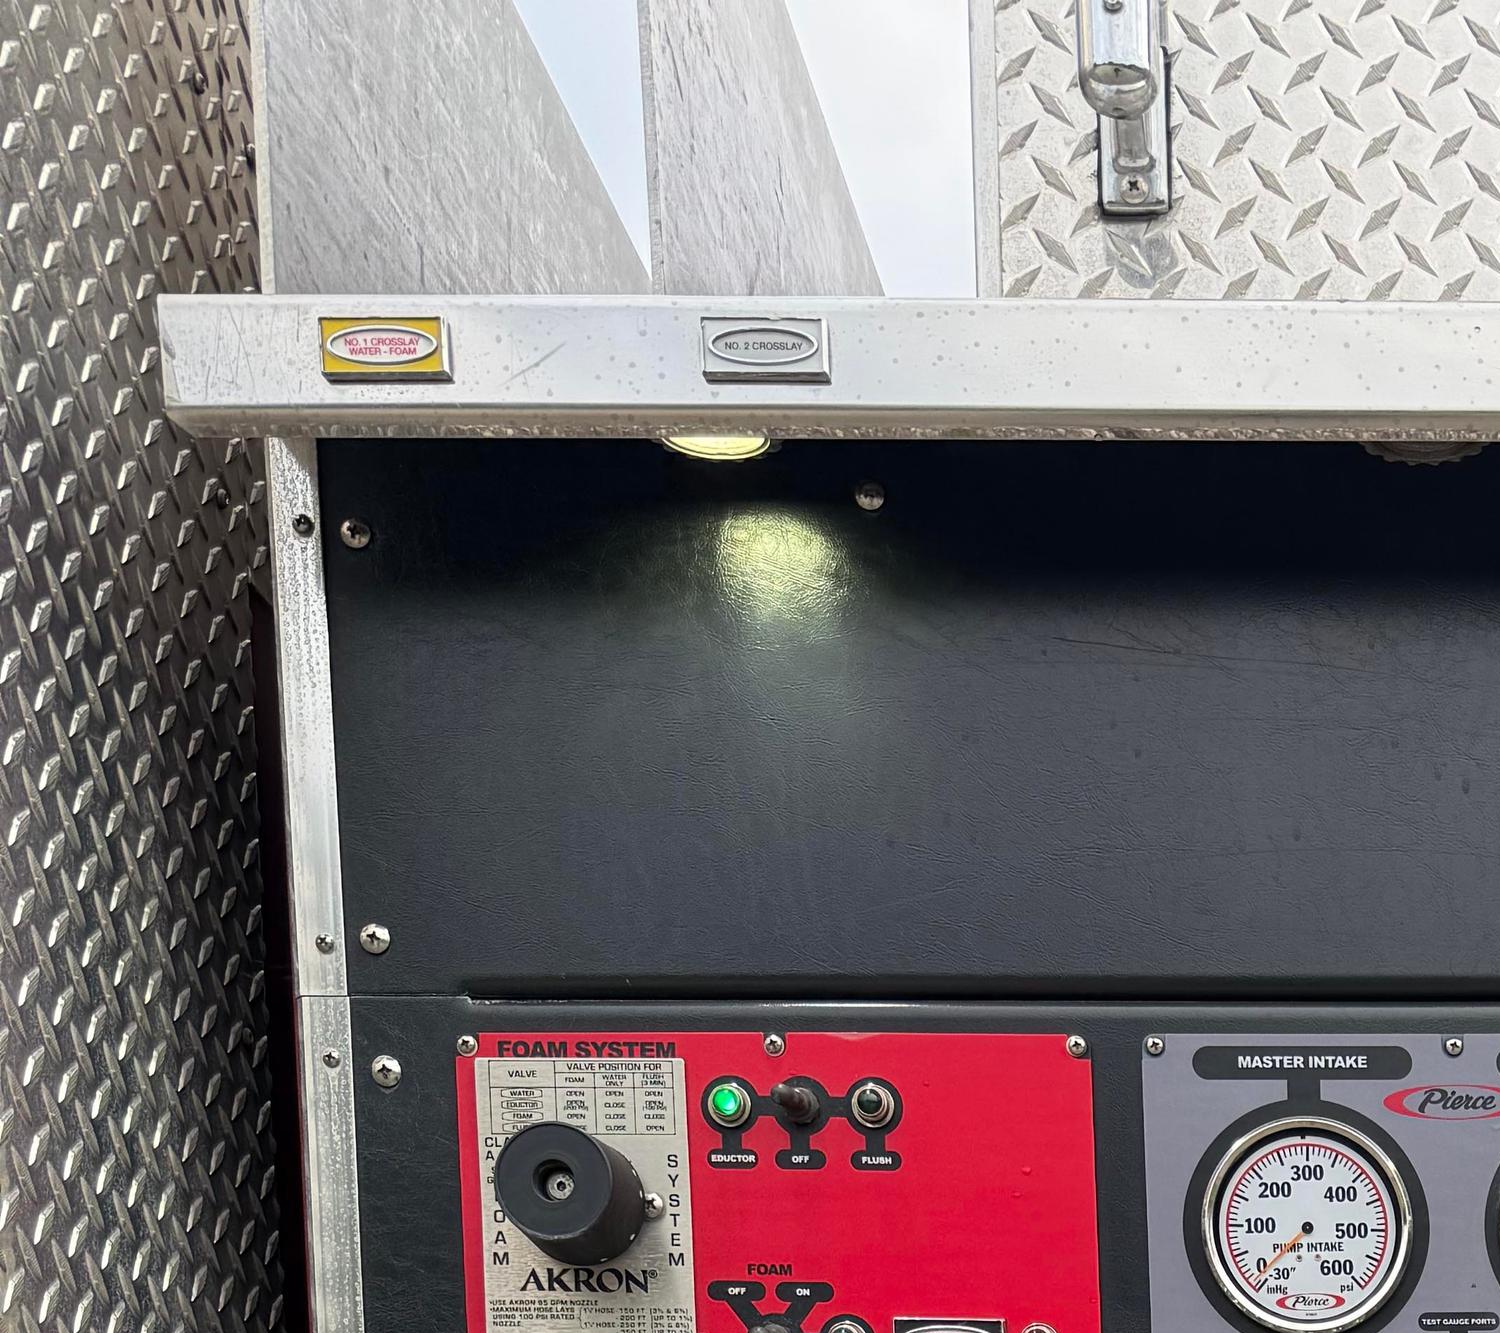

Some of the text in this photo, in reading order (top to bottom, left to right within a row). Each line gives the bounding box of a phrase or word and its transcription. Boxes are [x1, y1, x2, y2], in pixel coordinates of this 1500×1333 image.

[344, 337, 420, 346] NO. 1 CROSSLAY
[724, 342, 803, 351] NO. 2 CROSSLAY
[349, 347, 417, 356] WATER FOAM
[497, 1040, 676, 1058] FOAM SYSTEM
[566, 1063, 662, 1071] VALVE POSITION FOR
[1237, 1055, 1368, 1069] MASTER INTAKE
[507, 1070, 538, 1078] VALVE
[1417, 1088, 1497, 1114] Pierce
[711, 1154, 756, 1164] EDUCTOR
[791, 1154, 810, 1164] OFF
[861, 1155, 892, 1165] FLUSH
[747, 1263, 793, 1277] FOAM
[728, 1286, 747, 1296] OFF
[796, 1287, 811, 1296] ON
